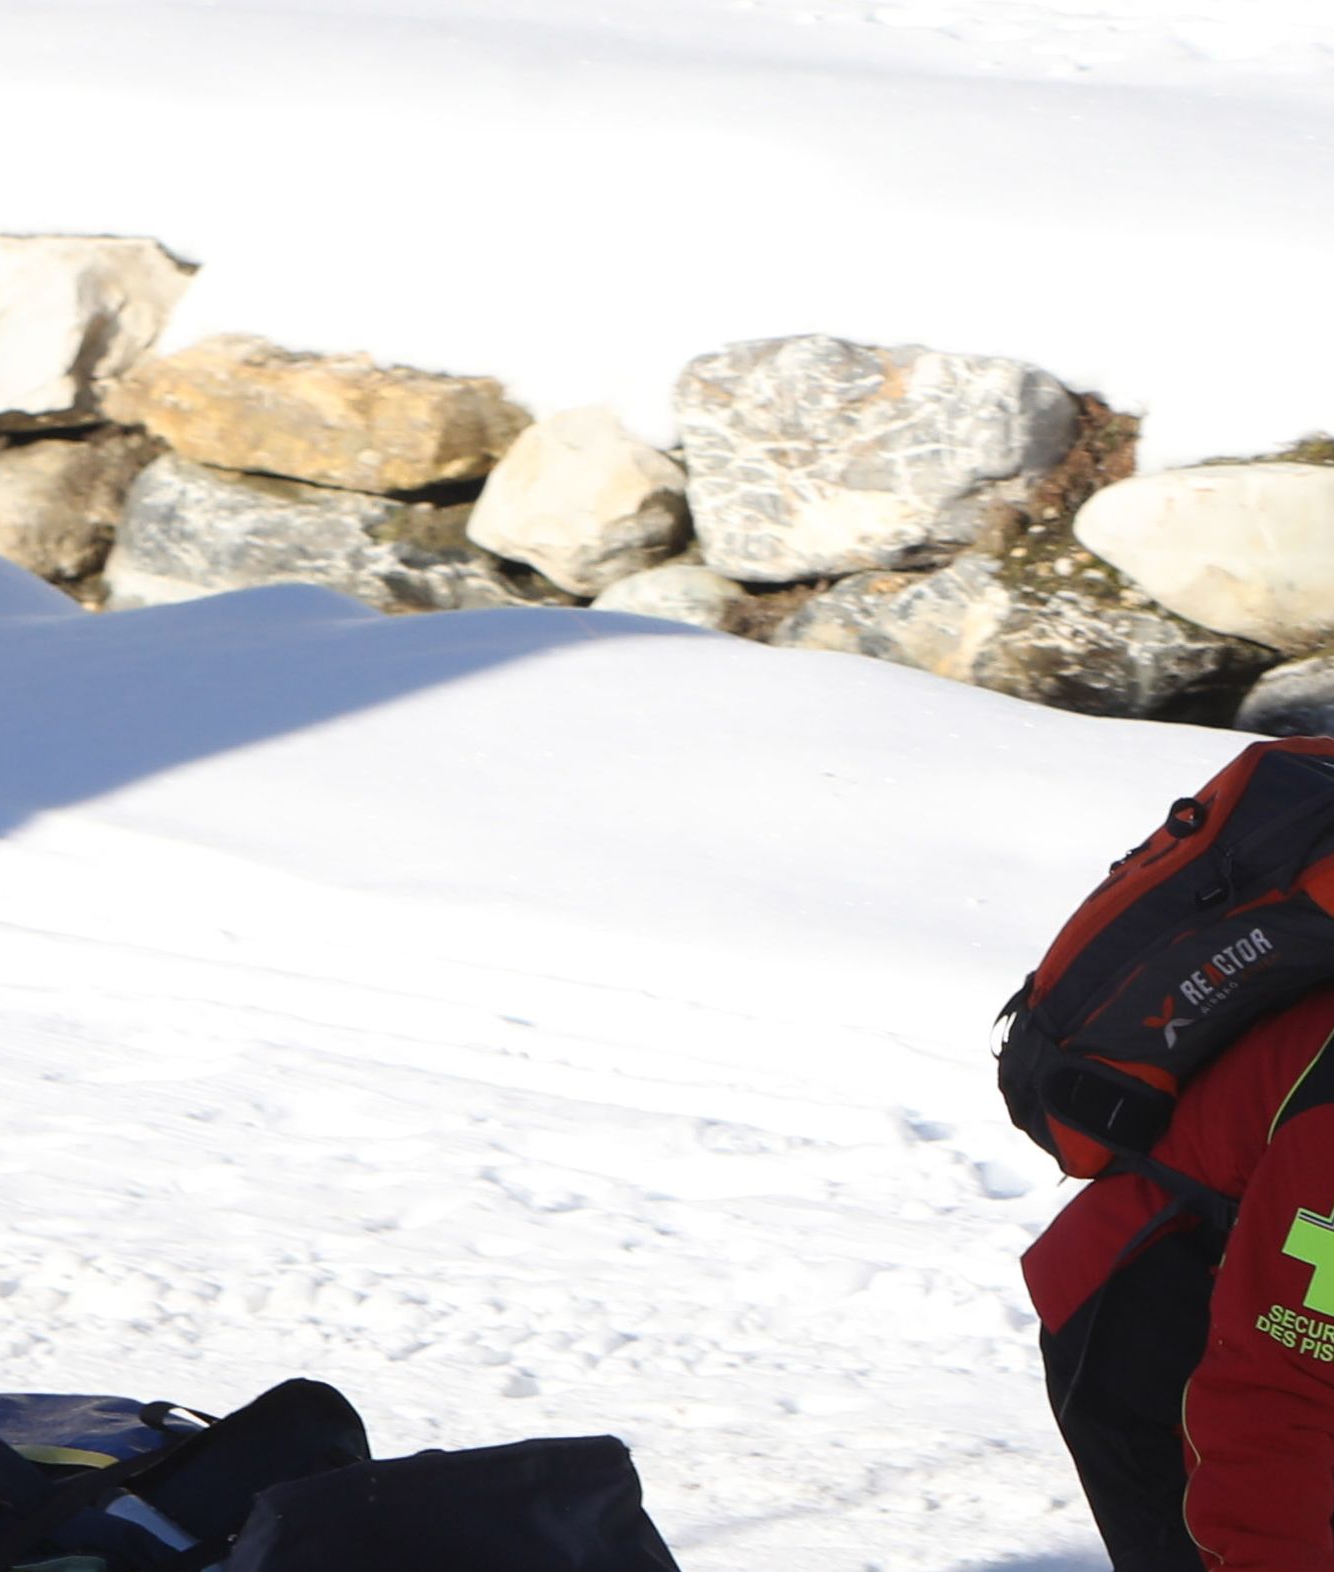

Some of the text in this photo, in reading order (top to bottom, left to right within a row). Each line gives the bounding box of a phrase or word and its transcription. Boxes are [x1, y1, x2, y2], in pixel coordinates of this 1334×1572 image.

[1179, 928, 1273, 1005] REACTOR
[1200, 982, 1239, 1015] AIRBAG
[1255, 1314, 1298, 1349] DES
